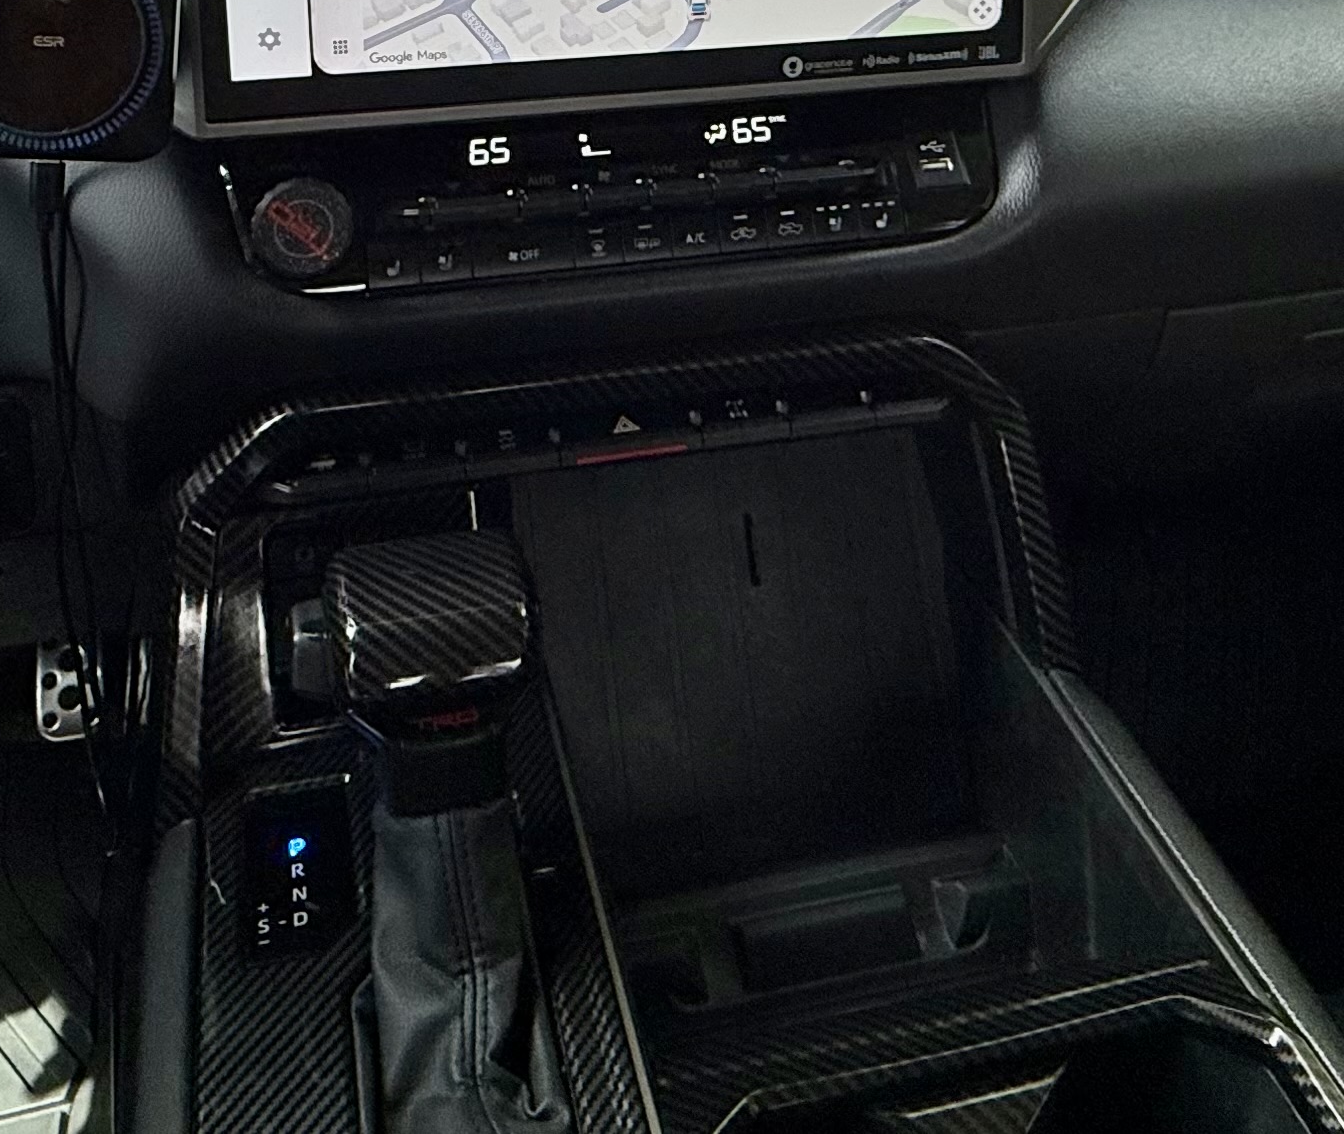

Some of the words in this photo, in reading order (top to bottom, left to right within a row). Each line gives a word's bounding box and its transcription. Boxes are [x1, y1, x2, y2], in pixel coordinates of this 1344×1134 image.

[460, 8, 476, 25] SE
[33, 35, 65, 47] ESR
[369, 50, 413, 64] Google
[417, 50, 448, 61] Maps
[732, 116, 772, 144] 65
[469, 137, 511, 166] 65
[686, 232, 706, 244] A/C
[519, 249, 540, 261] OFF
[288, 837, 307, 857] P
[291, 862, 305, 879] R
[292, 886, 307, 902] N
[258, 918, 270, 935] S
[293, 911, 308, 927] D
